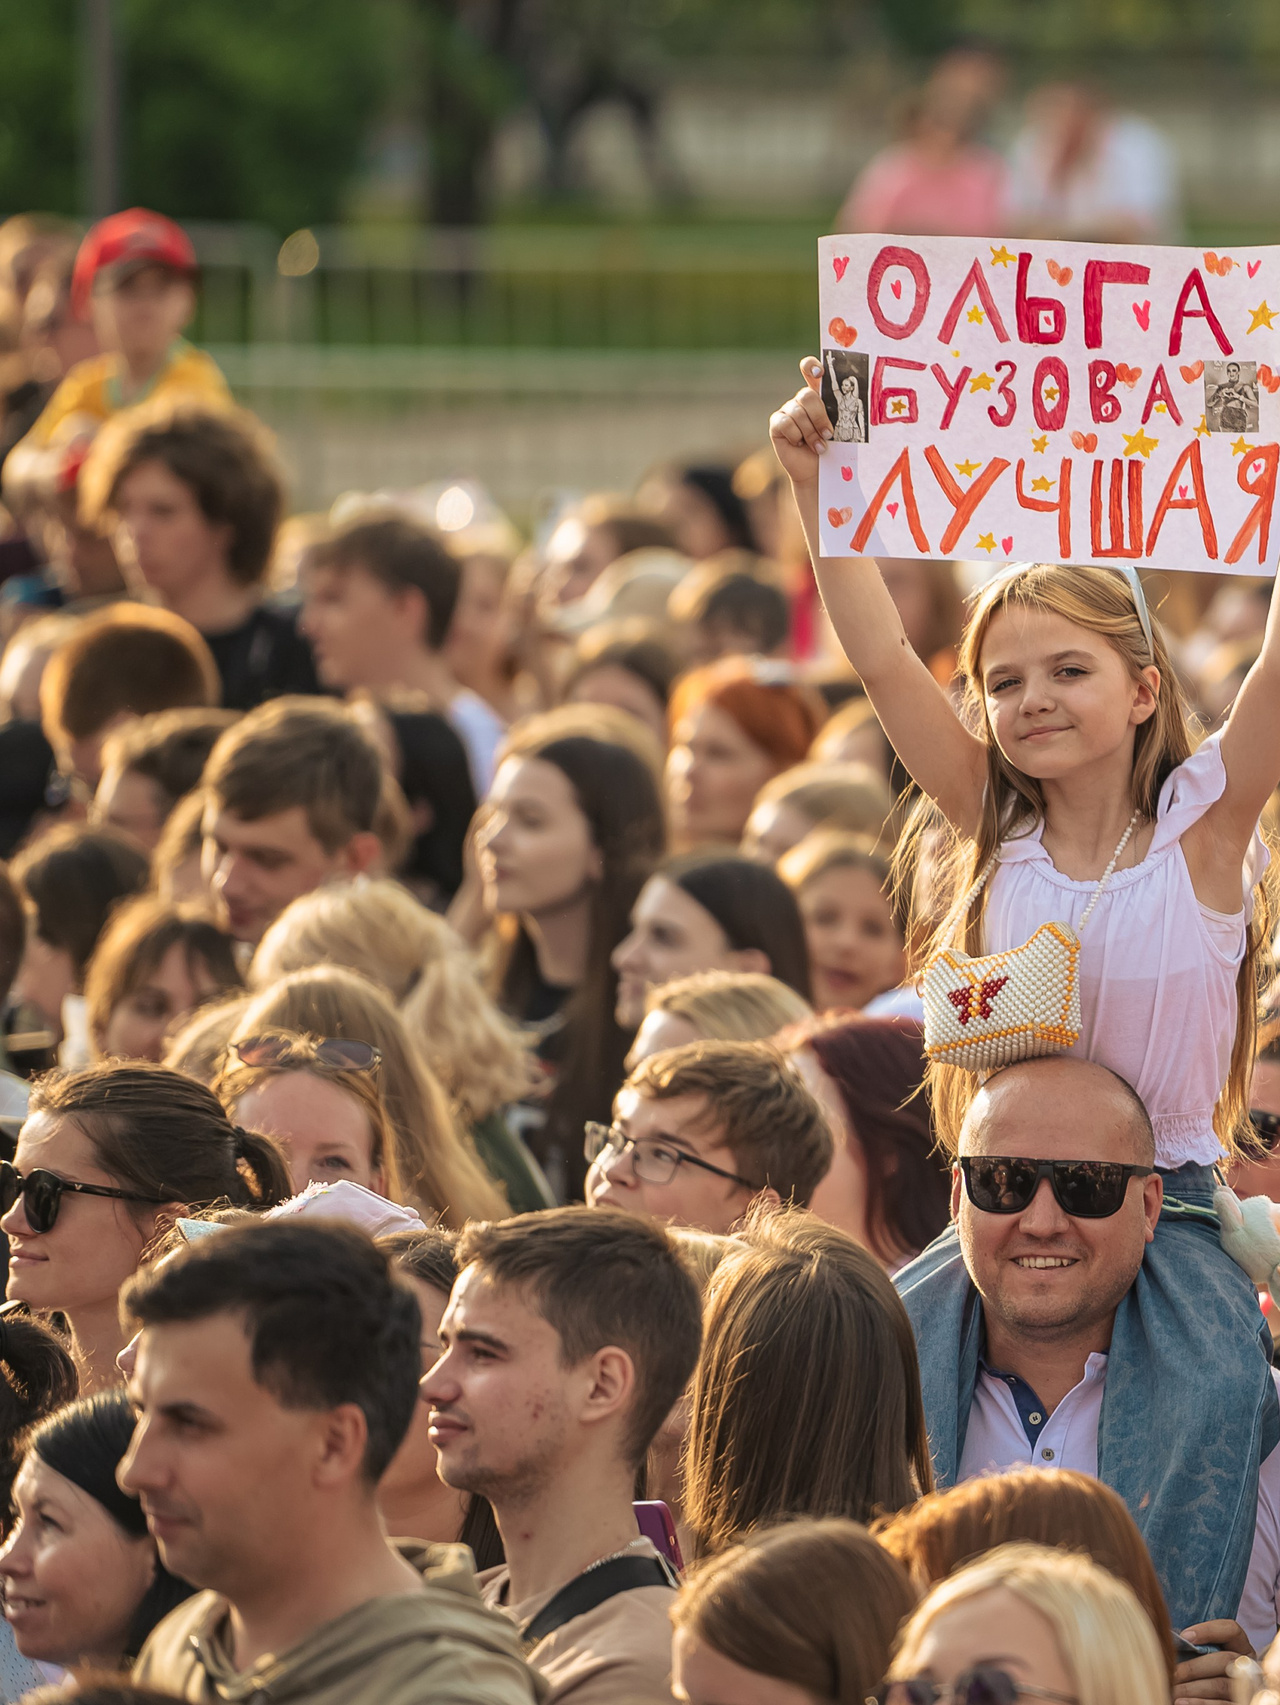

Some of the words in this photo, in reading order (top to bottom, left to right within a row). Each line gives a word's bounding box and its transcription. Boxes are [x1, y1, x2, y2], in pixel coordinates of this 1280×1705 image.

[866, 244, 1234, 357] ОЛЬГА
[869, 355, 1184, 432] БУЗОВА
[848, 437, 1280, 566] ЛУЧШАЯ
